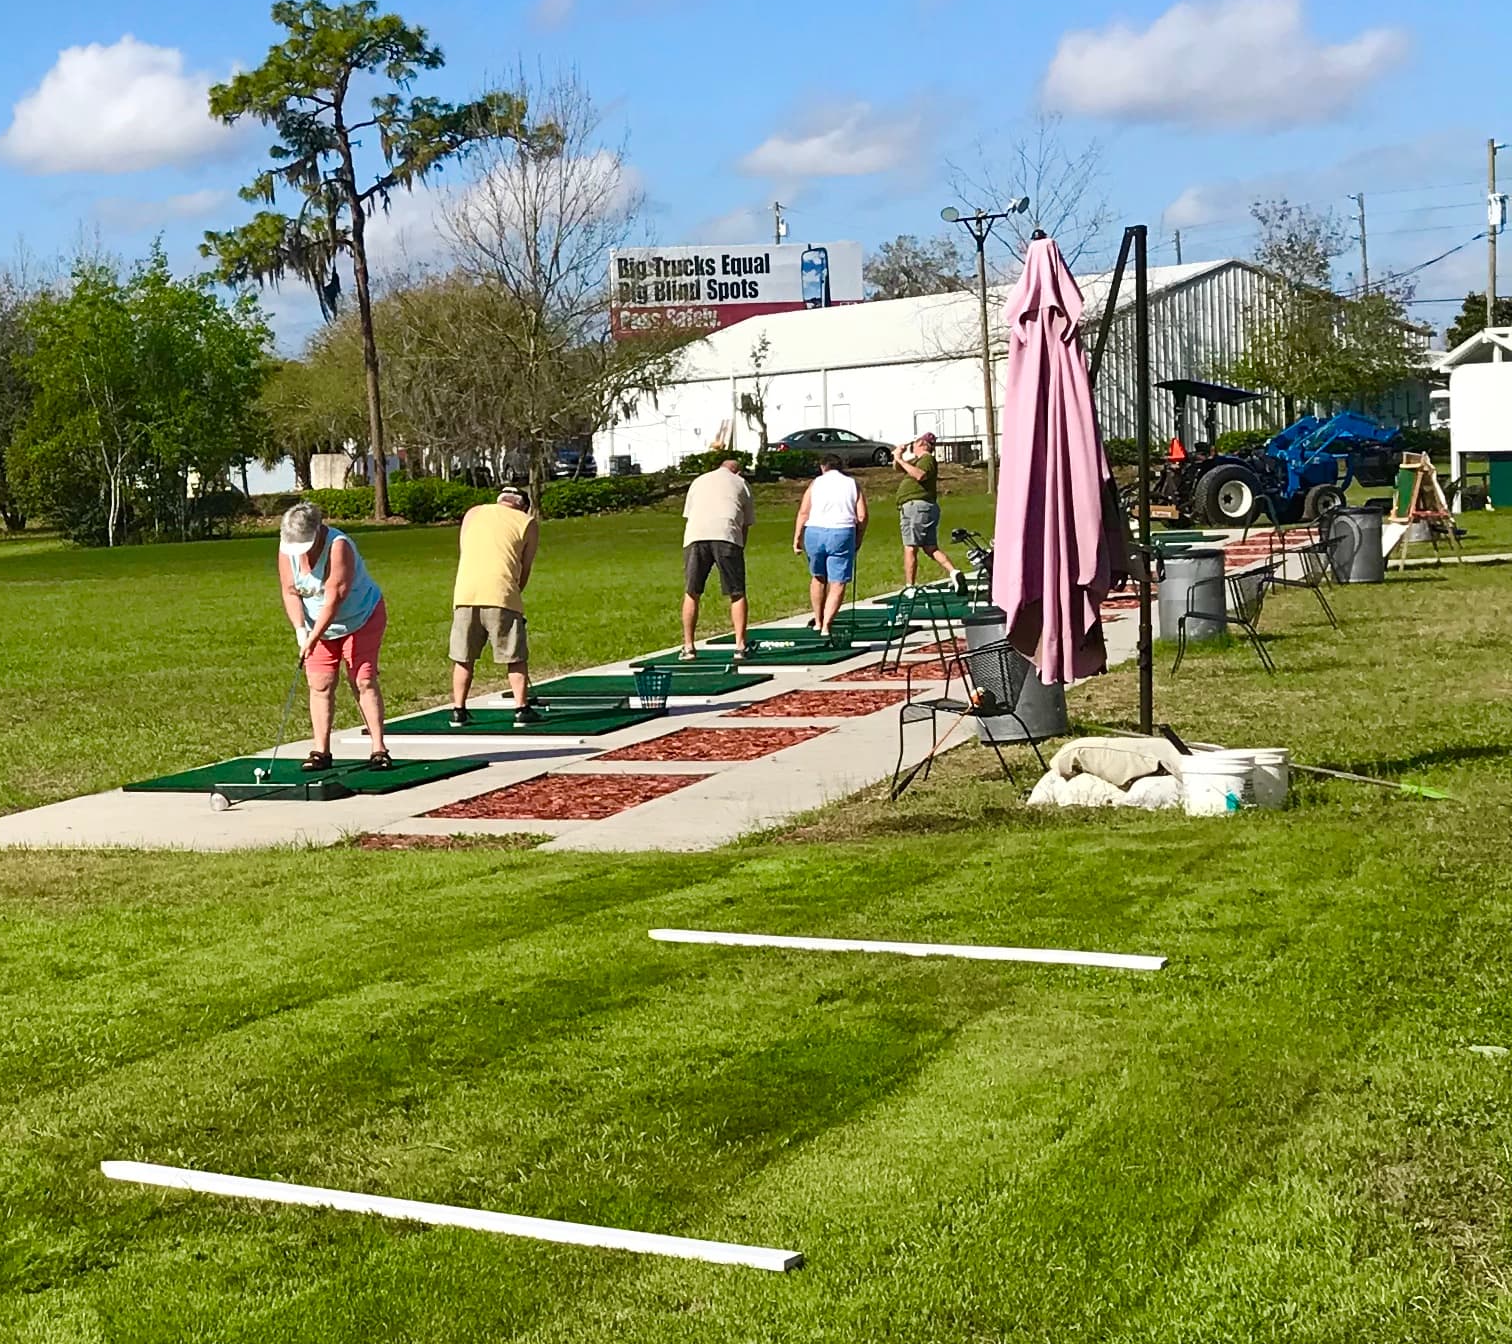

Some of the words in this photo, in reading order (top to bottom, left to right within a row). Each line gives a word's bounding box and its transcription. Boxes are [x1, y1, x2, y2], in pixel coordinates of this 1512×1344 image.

[617, 257, 647, 280] Big
[653, 255, 716, 278] Trucks
[721, 253, 770, 277] Equal
[618, 281, 648, 304] Big
[654, 278, 701, 302] Blind
[706, 278, 759, 302] Spots
[619, 310, 662, 330] Pass
